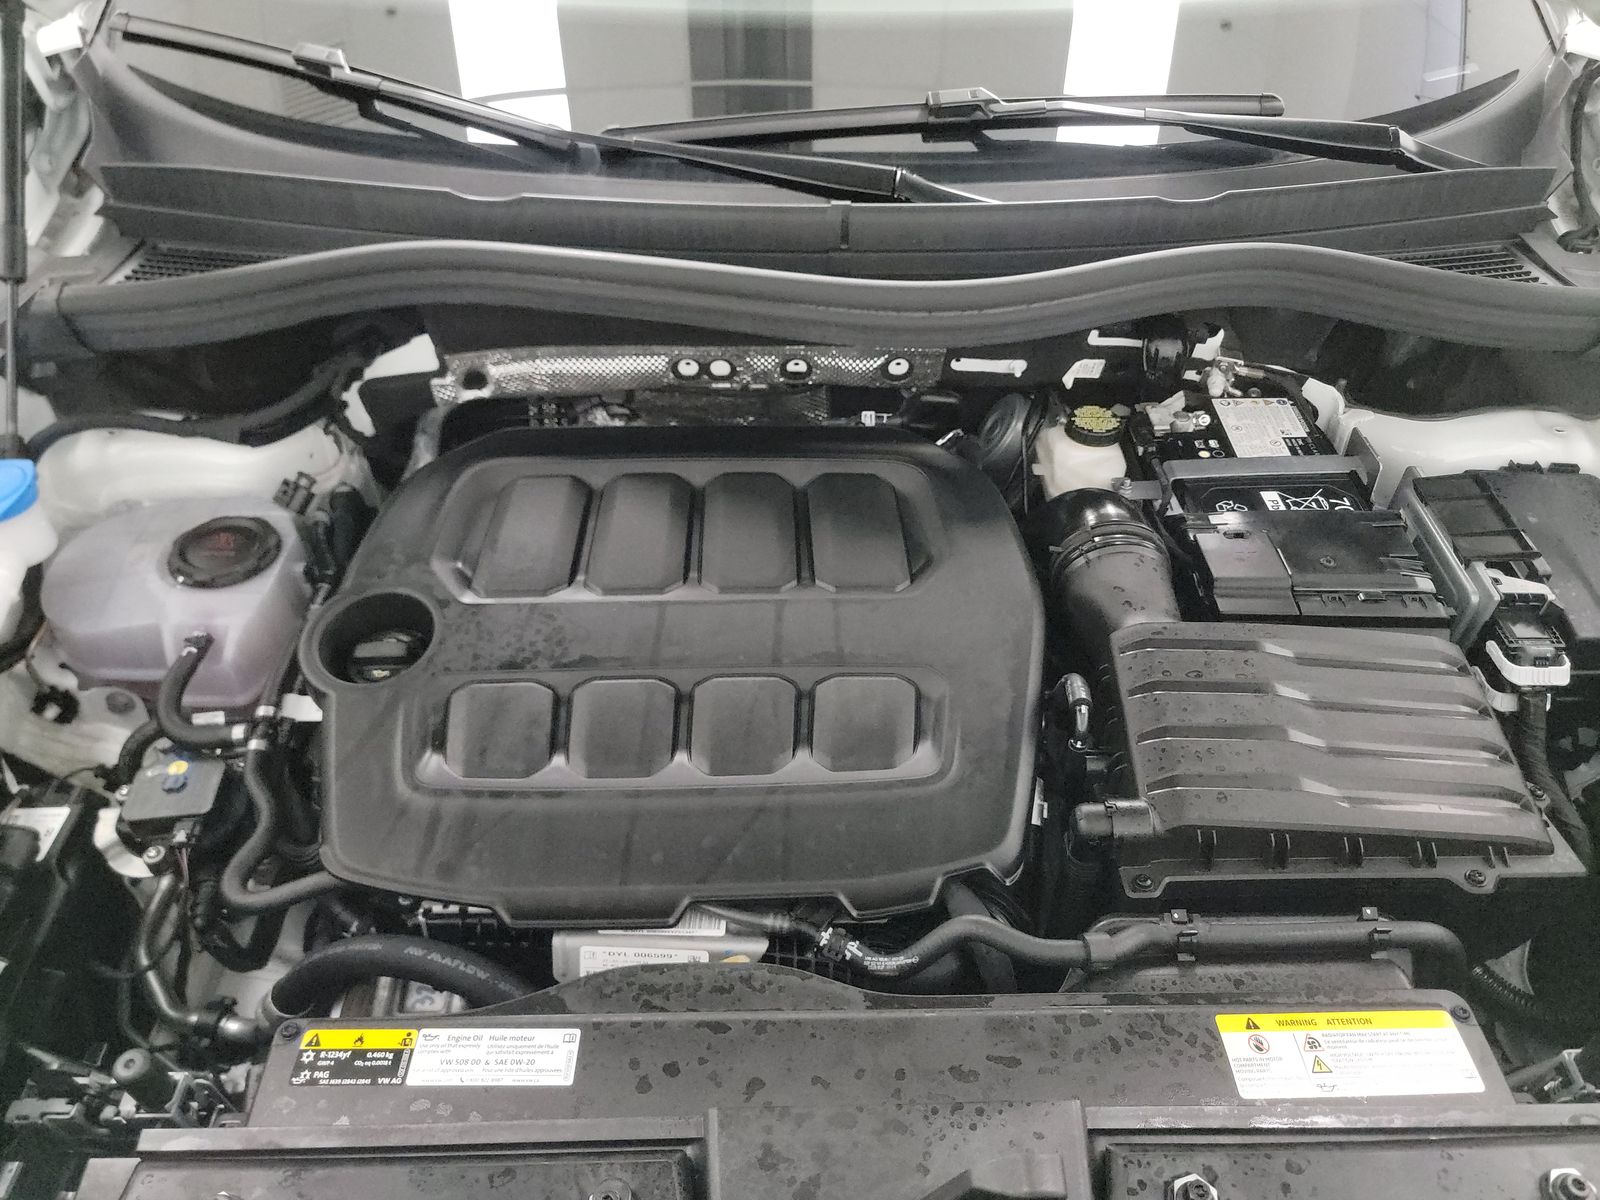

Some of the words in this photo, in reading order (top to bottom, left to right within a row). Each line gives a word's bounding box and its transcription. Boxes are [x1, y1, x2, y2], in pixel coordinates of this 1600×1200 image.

[1275, 1018, 1318, 1027] WARNING
[1326, 1017, 1373, 1026] ATTENTION
[447, 1034, 472, 1043] Engine
[472, 1034, 484, 1042] Oil
[488, 1034, 508, 1042] Huile
[319, 1050, 353, 1060] R-1234yf
[366, 1051, 386, 1059] 0.460
[385, 1051, 395, 1060] kg
[440, 1058, 454, 1066] VW
[455, 1058, 470, 1066] 508
[470, 1058, 482, 1066] 00
[494, 1058, 509, 1066] SAE
[510, 1058, 536, 1066] 0W-20
[313, 1070, 330, 1079] PAG
[377, 1077, 391, 1085] VW
[390, 1077, 403, 1085] AG
